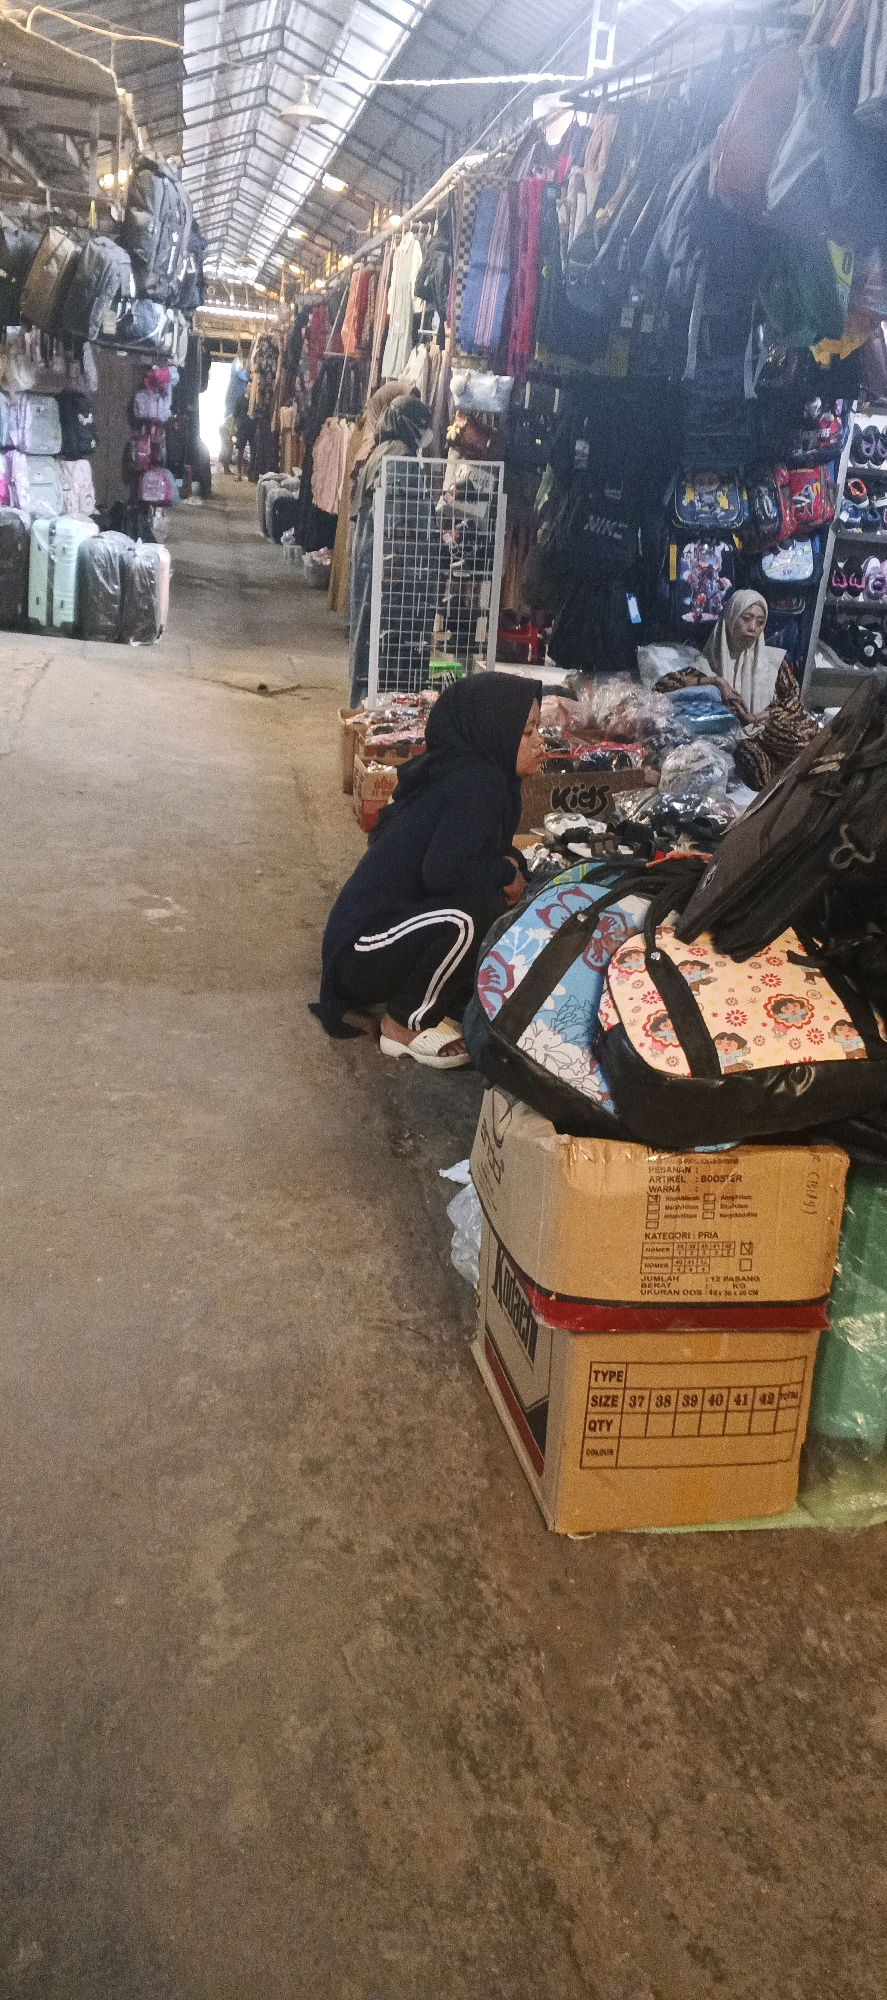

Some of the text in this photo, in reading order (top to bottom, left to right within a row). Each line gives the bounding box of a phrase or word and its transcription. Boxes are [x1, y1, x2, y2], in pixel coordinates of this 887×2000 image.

[648, 1166, 692, 1174] PESANAN
[648, 1175, 687, 1183] ARTIKEL
[701, 1174, 743, 1183] BOOSTER
[648, 1185, 681, 1193] WARNA
[644, 1232, 691, 1240] KATEGORI
[698, 1231, 719, 1239] PRIA
[593, 1369, 624, 1383] TYPE
[590, 1394, 619, 1408] SIZE
[628, 1394, 646, 1408] 37
[655, 1394, 672, 1408] 38
[682, 1393, 699, 1408] 39
[708, 1392, 724, 1406] 40
[733, 1392, 749, 1406] 41
[759, 1392, 775, 1406] 42
[588, 1419, 613, 1432] QTY
[586, 1448, 614, 1457] COLOUR
